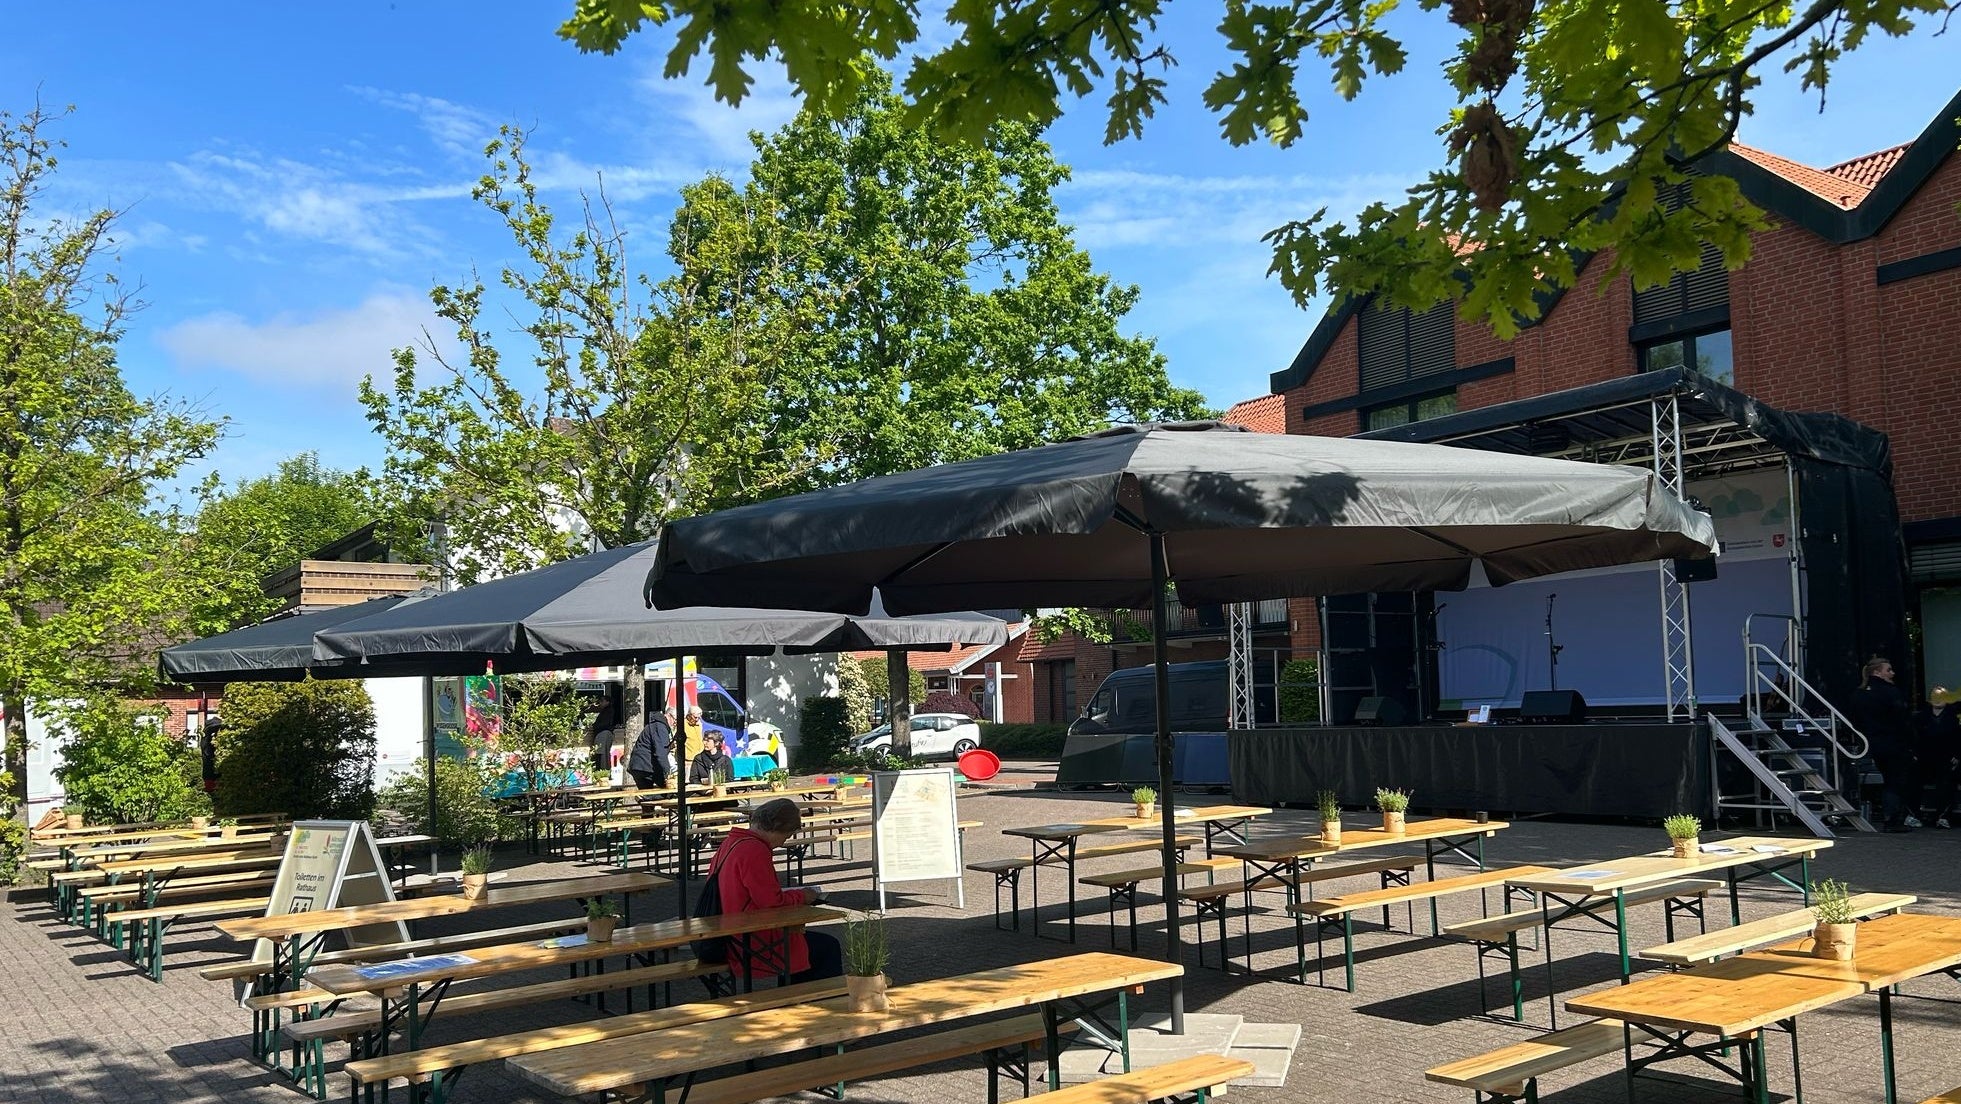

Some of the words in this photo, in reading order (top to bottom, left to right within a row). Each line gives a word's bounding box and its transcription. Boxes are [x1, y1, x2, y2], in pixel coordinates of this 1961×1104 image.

[295, 872, 317, 881] Toiletten
[317, 873, 325, 881] im
[296, 883, 317, 892] Rathaus
